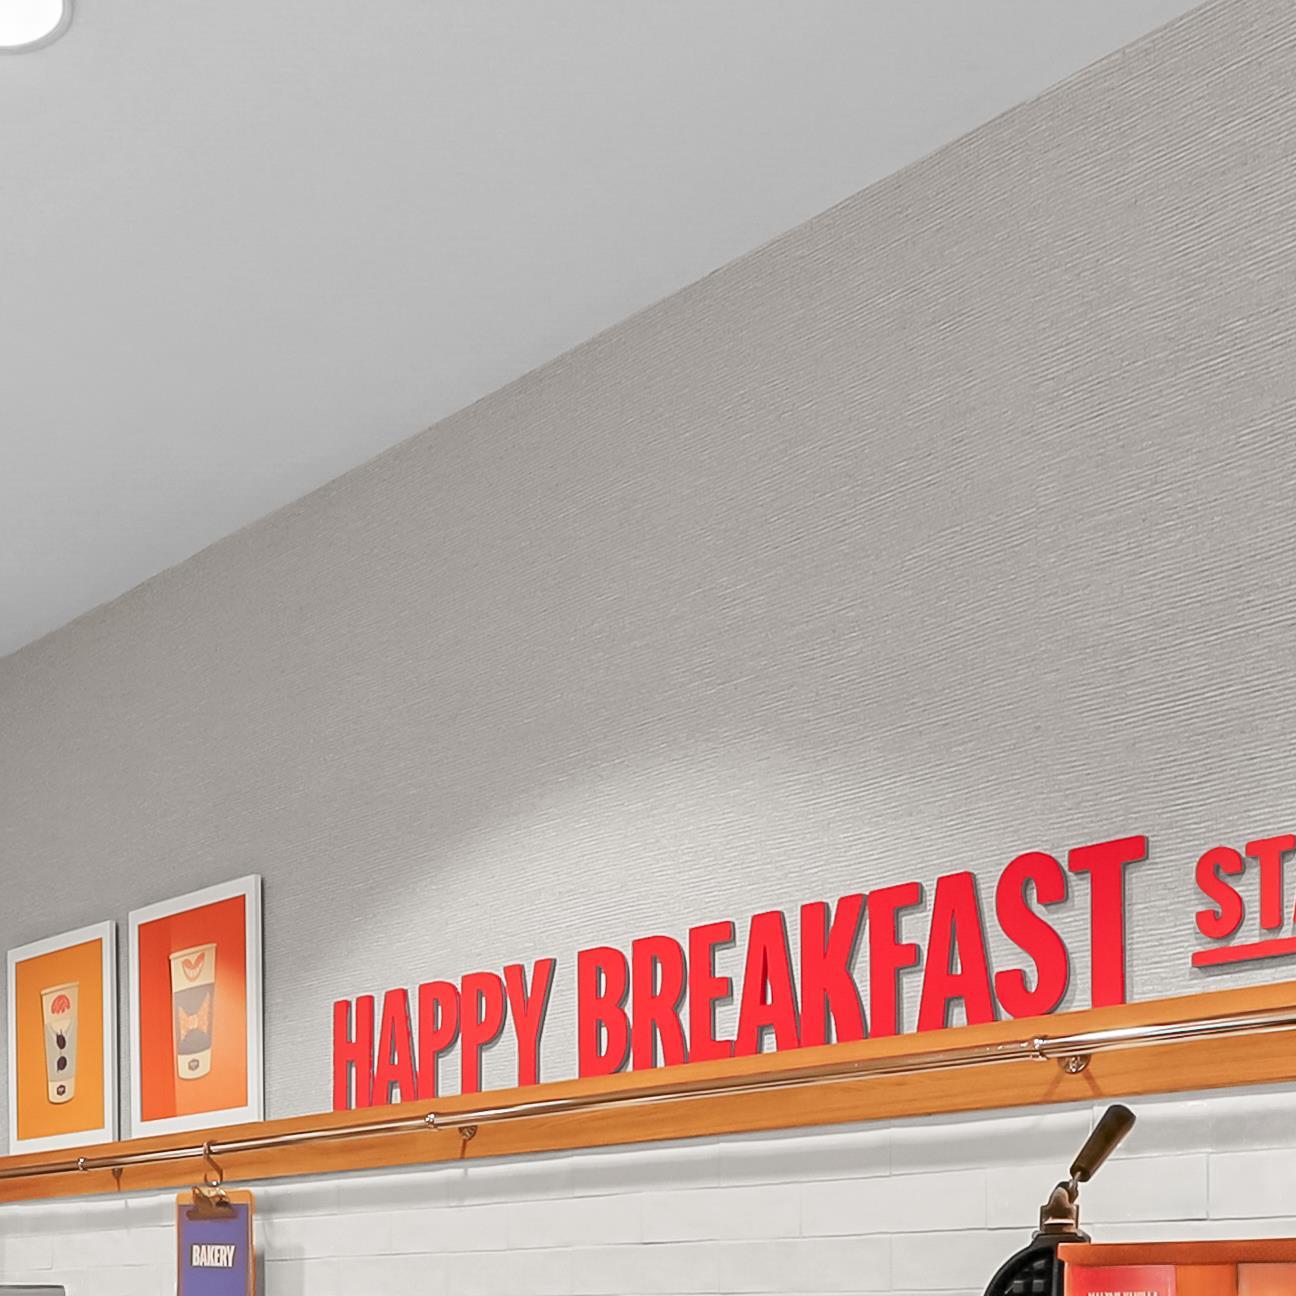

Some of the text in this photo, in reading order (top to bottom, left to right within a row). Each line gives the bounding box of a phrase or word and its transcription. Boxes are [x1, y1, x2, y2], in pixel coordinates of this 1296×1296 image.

[333, 957, 557, 1111] HAPPY
[577, 835, 1147, 1078] BREAKFAST
[191, 1244, 236, 1268] BAKERY
